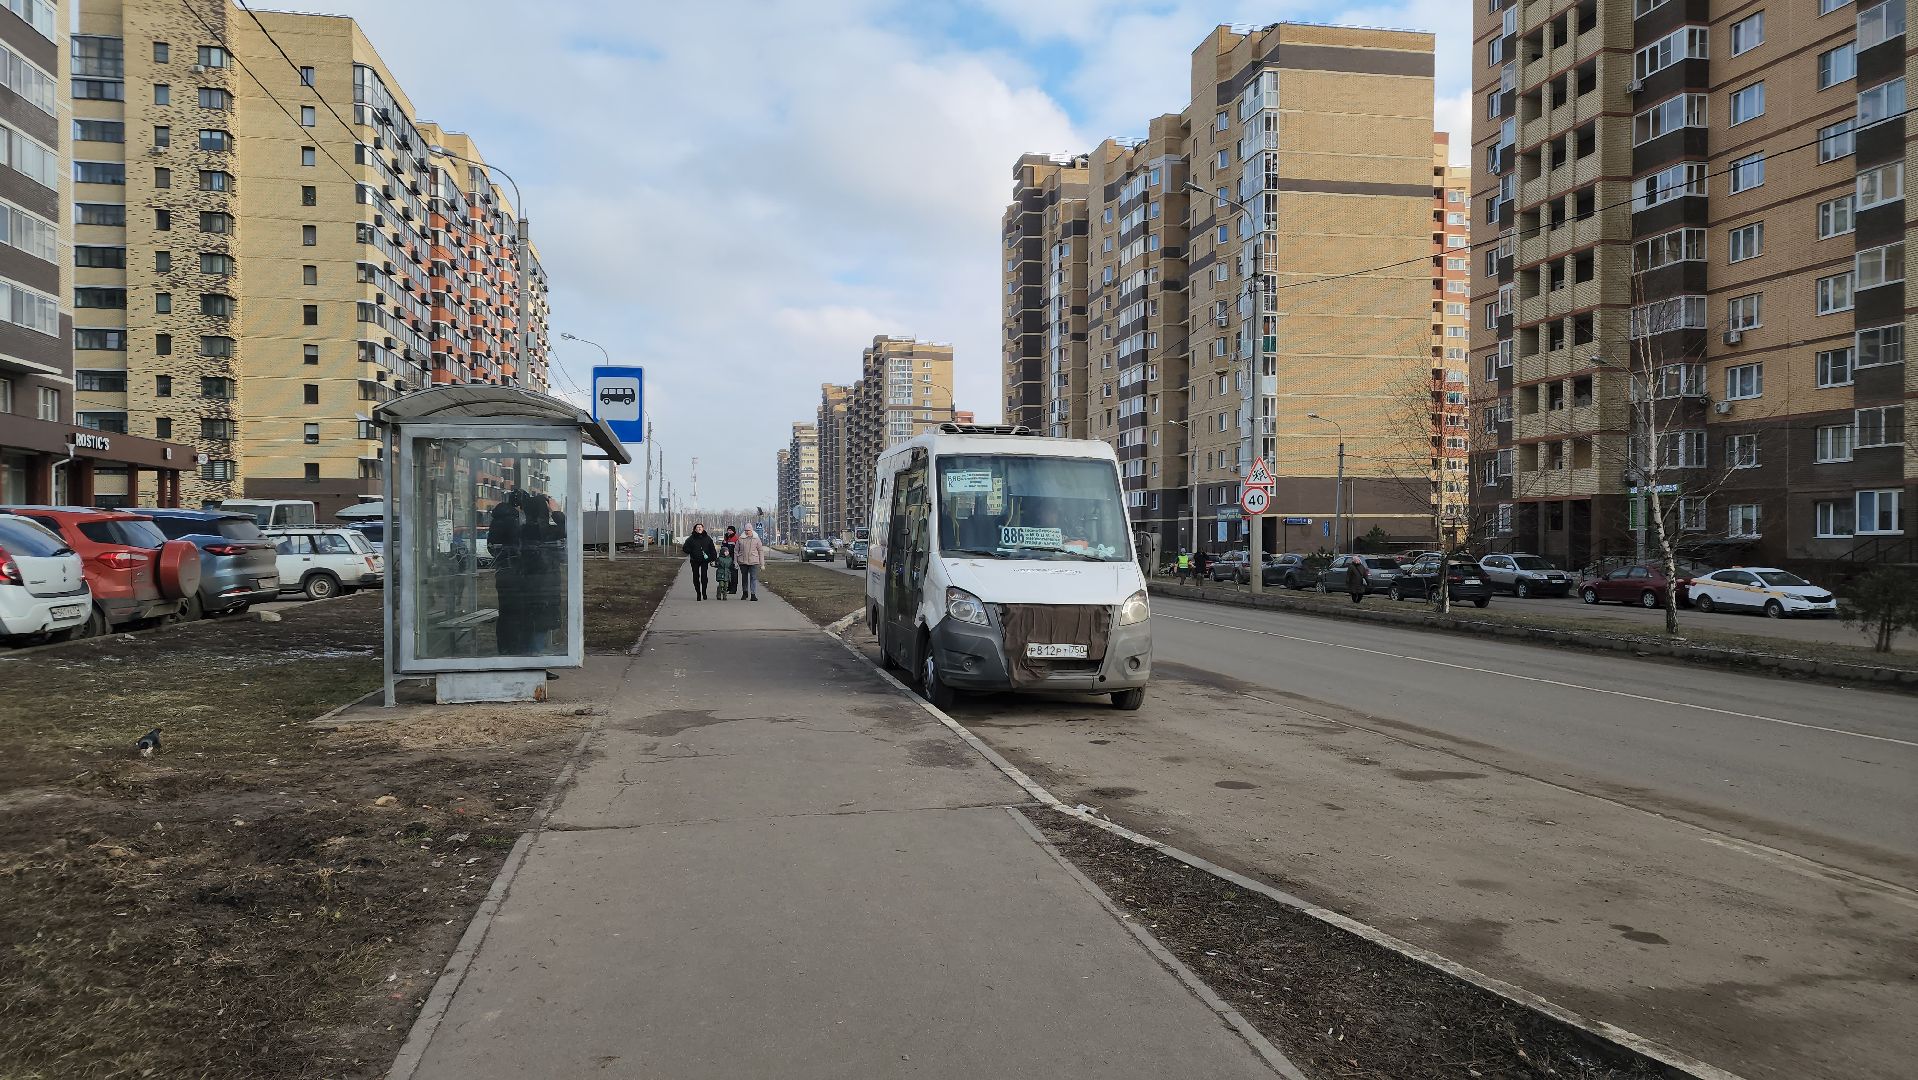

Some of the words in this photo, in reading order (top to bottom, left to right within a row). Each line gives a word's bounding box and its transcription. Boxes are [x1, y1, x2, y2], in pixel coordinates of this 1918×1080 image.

[75, 432, 110, 451] ROSTIC'S
[1248, 495, 1264, 505] 40
[1004, 527, 1024, 543] 886
